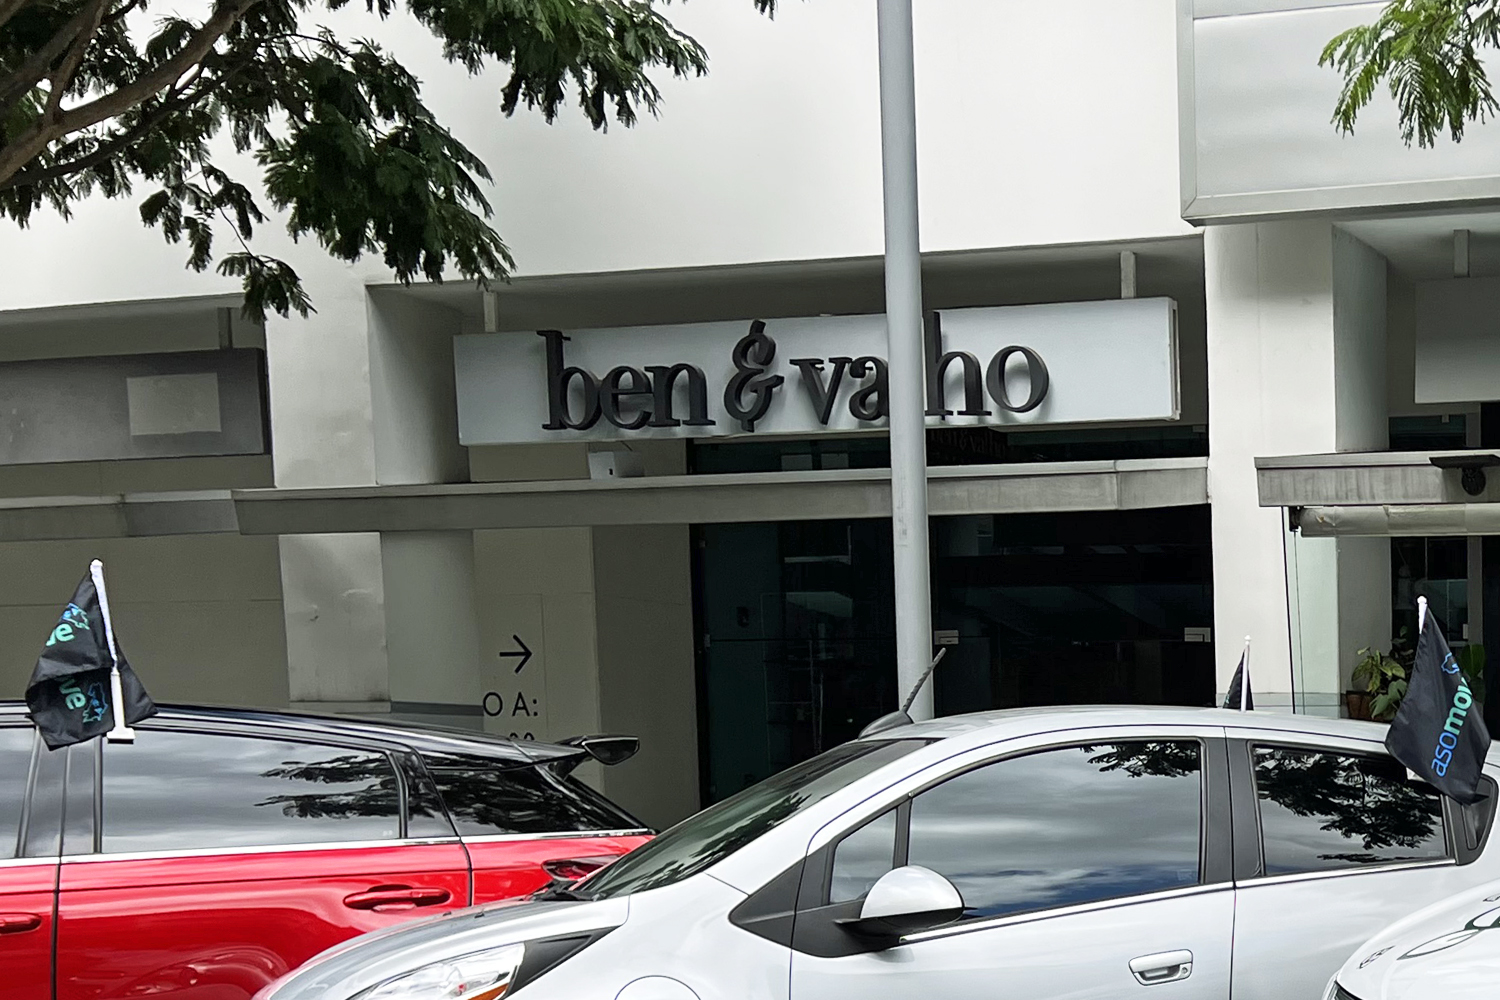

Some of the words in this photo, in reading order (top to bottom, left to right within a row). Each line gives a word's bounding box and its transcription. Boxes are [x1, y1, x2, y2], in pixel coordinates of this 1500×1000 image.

[536, 330, 716, 430] ben
[724, 319, 785, 433] &
[789, 310, 1050, 426] vaho
[512, 691, 538, 717] A:
